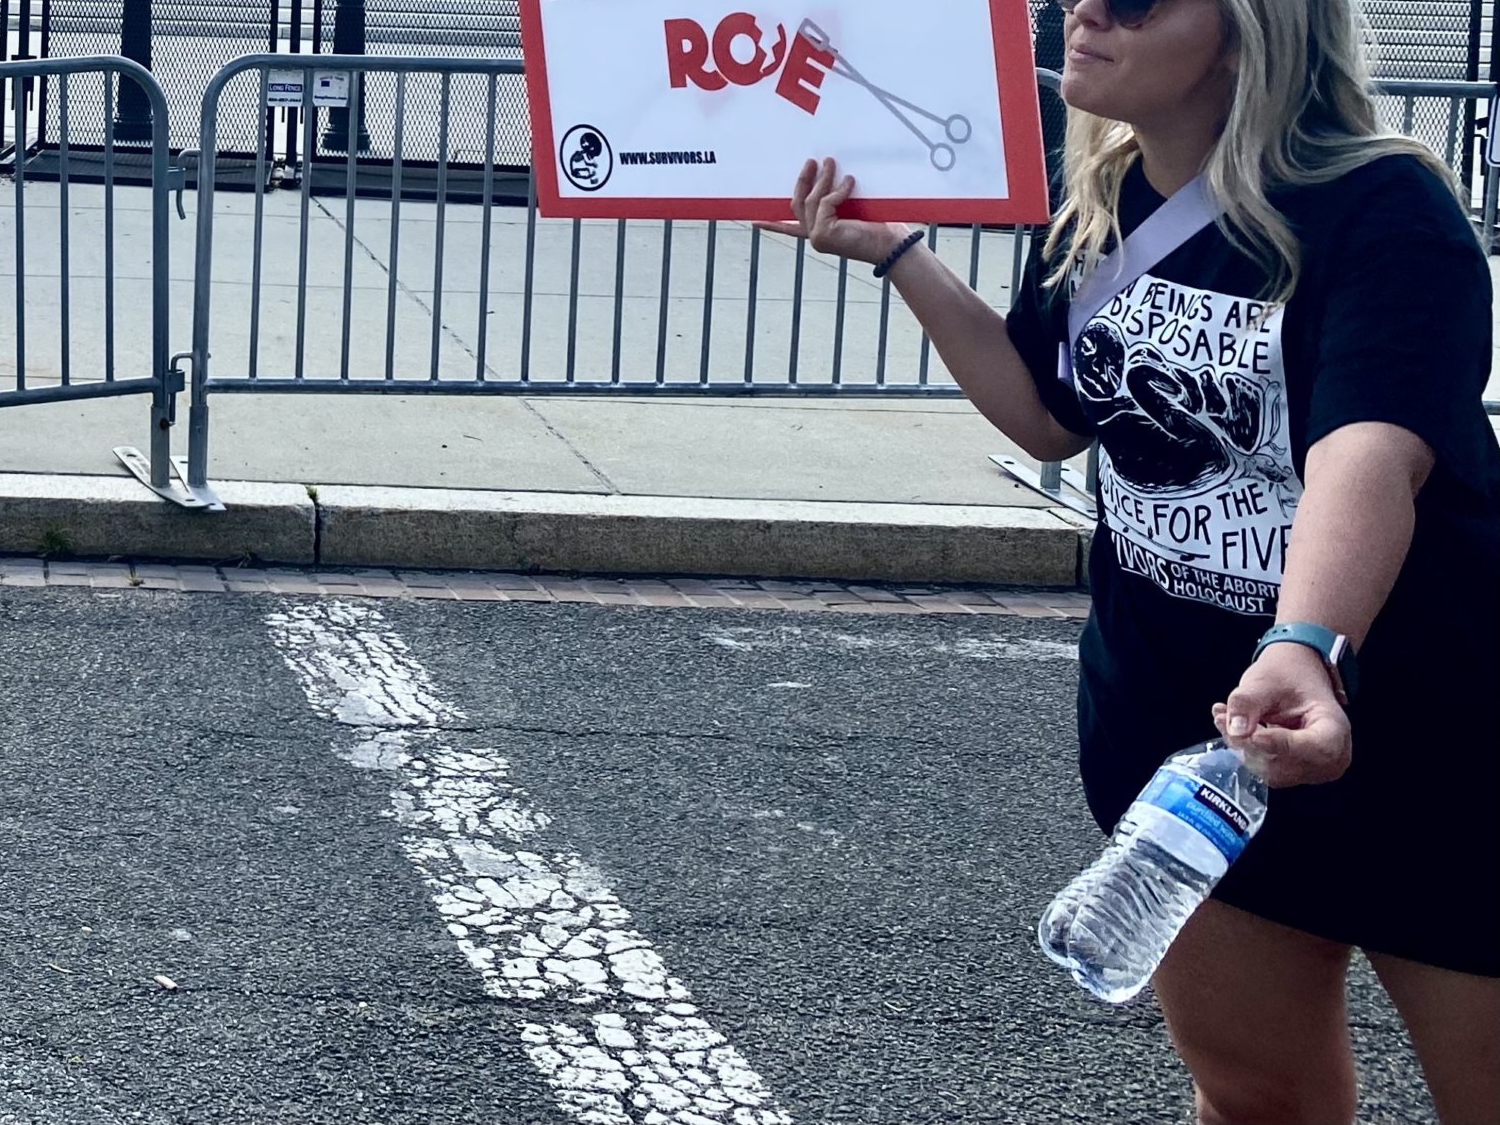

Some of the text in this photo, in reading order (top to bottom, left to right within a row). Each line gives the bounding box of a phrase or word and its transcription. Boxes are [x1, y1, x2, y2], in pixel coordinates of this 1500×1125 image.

[664, 11, 838, 116] ROE
[619, 150, 717, 165] WWW.SURVIVORS.LA
[1140, 282, 1213, 322] BEINGS
[1109, 296, 1271, 375] DISPOSABLE
[1153, 503, 1212, 546] FOR
[1216, 482, 1268, 520] THE
[1170, 562, 1281, 599] OF THE ABORT
[1173, 579, 1266, 613] HOLOCAUST
[1200, 787, 1248, 831] KIRKLAND
